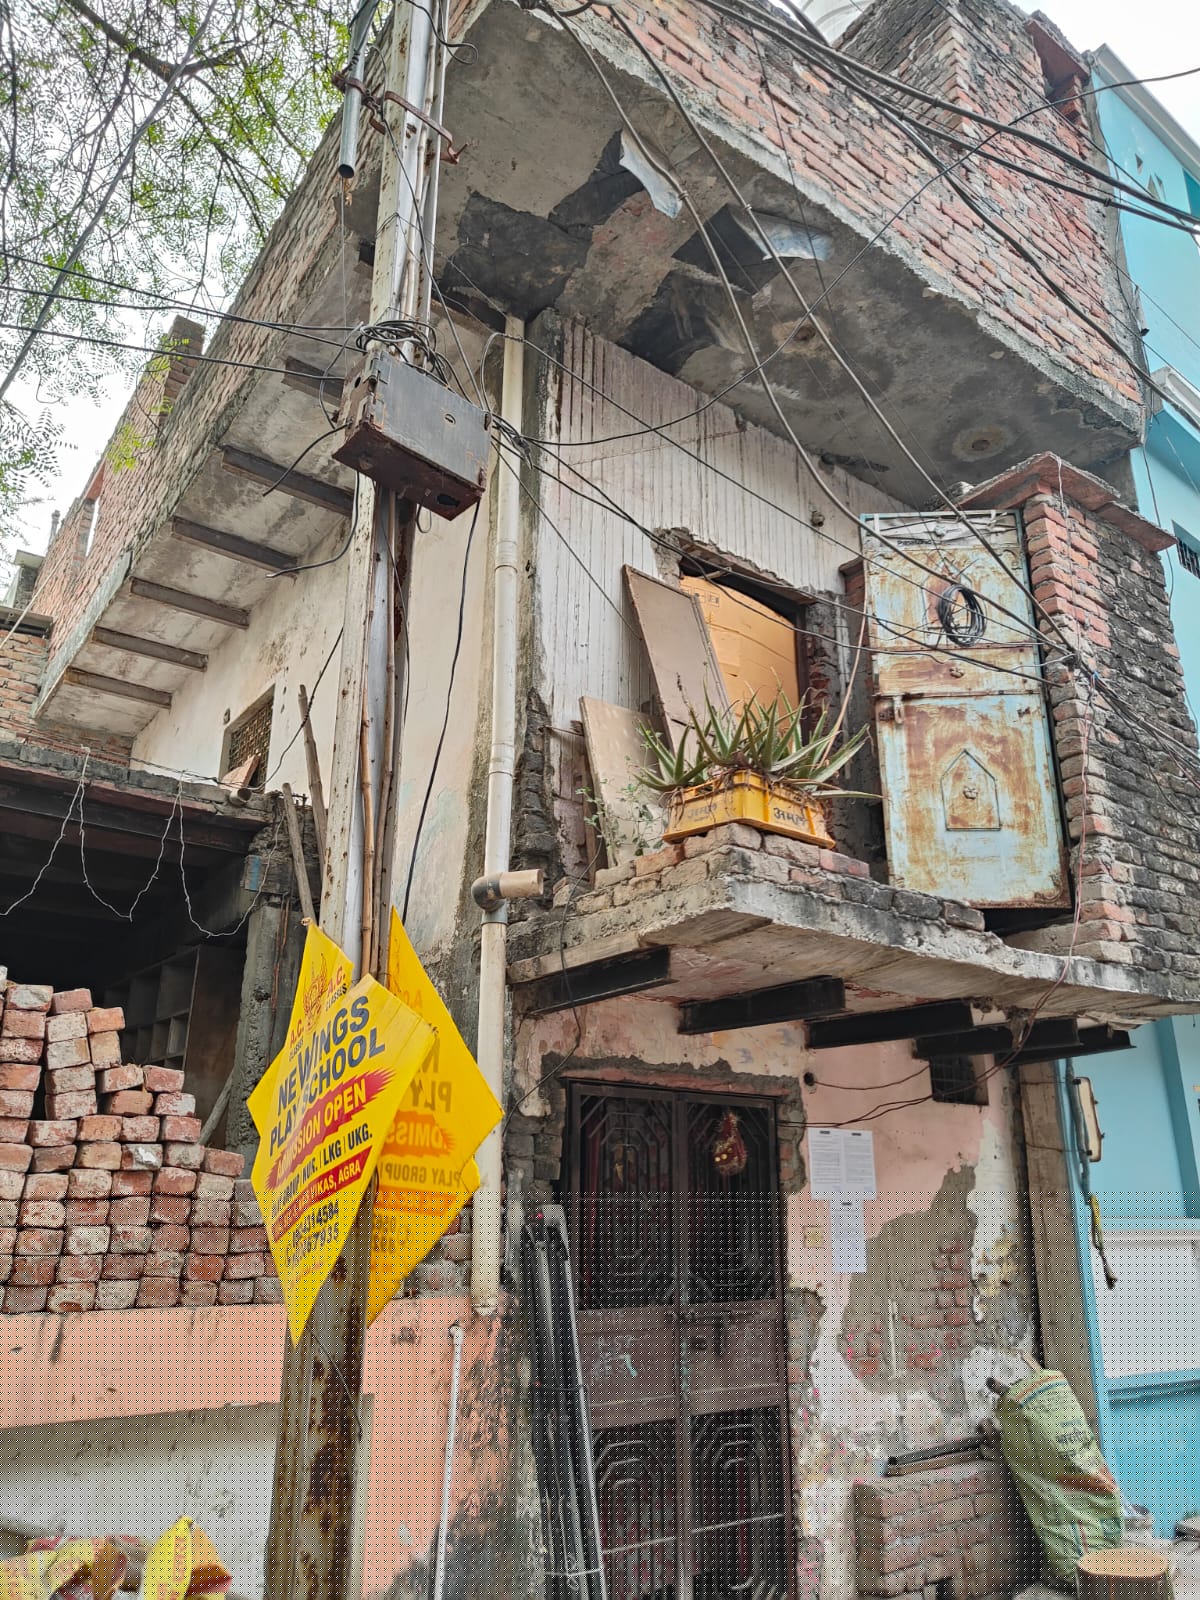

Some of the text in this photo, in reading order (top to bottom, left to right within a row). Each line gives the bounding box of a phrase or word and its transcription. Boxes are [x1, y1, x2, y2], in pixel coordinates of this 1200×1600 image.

[323, 1078, 367, 1128] OPEN
[323, 1140, 341, 1166] LKG
[347, 1123, 373, 1151] UKG.
[338, 1159, 361, 1184] AGRA
